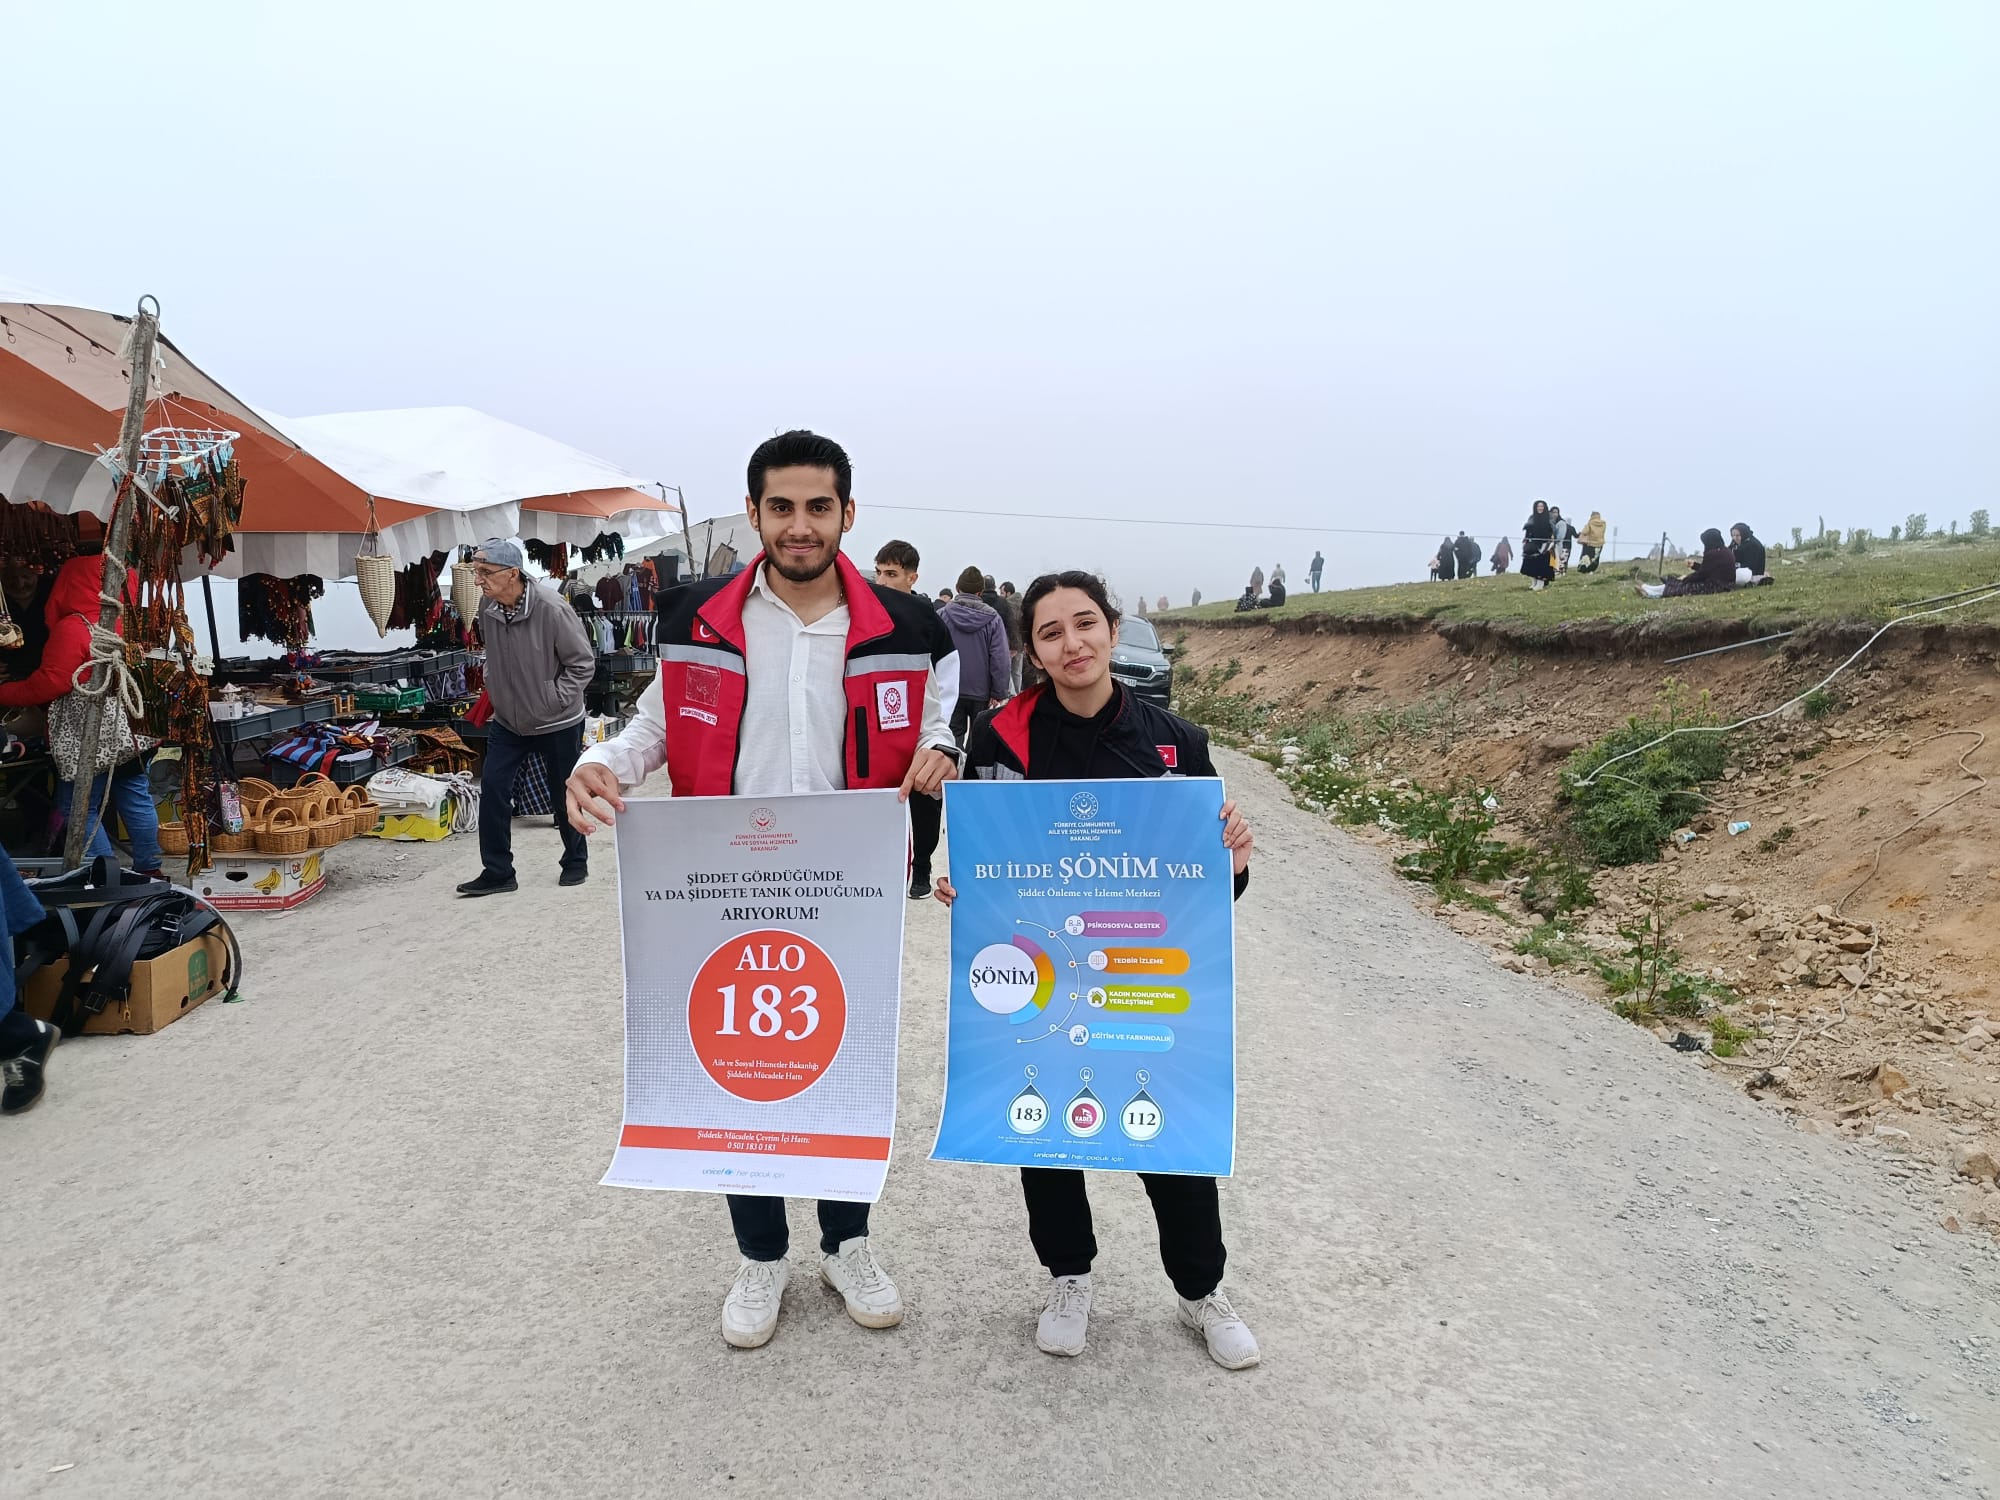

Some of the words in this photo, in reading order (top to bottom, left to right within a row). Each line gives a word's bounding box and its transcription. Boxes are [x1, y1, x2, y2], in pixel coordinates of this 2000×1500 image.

[974, 863, 1002, 880] BU
[1006, 860, 1054, 880] İLDE
[1058, 852, 1159, 885] ŞÖNİM
[1164, 863, 1207, 880] VAR
[687, 871, 739, 886] ŞİDDET
[741, 869, 844, 883] GÖRDÜĞÜMDE
[644, 890, 662, 901] YA
[665, 889, 686, 900] DA
[687, 887, 748, 902] ŞİDDETE
[749, 887, 793, 898] TANIK
[794, 884, 885, 898] OLDUĞUMDA
[1017, 888, 1046, 899] Şiddet
[1083, 890, 1092, 898] ve
[1094, 887, 1124, 898] İzleme
[1125, 888, 1161, 898] Merkezi
[720, 906, 820, 921] ARIYORUM!
[1087, 921, 1133, 929] PSİKOSOSYAL
[735, 944, 806, 972] ALO
[1113, 956, 1138, 964] TEDBİR
[1139, 956, 1165, 965] İZLEME
[971, 966, 1036, 988] ŞÖNİM
[1108, 998, 1154, 1006] YERLEŞTİRME
[1131, 991, 1176, 999] KONUKEVİNE
[715, 984, 820, 1041] 183
[1126, 1034, 1172, 1042] FARKINDALIK
[734, 1060, 755, 1069] Sosyal
[755, 1060, 788, 1069] Hizmetler
[788, 1061, 819, 1072] Bakanlığı
[726, 1070, 752, 1079] Şiddetle
[753, 1071, 784, 1080] Mücadele
[785, 1072, 803, 1081] Hattı
[1015, 1107, 1043, 1121] 183
[1127, 1112, 1156, 1126] 112
[697, 1130, 723, 1140] Şiddetle
[724, 1131, 755, 1141] Mücadele
[755, 1133, 780, 1142] Çevrim
[781, 1134, 790, 1144] İçi
[763, 1143, 776, 1151] 183
